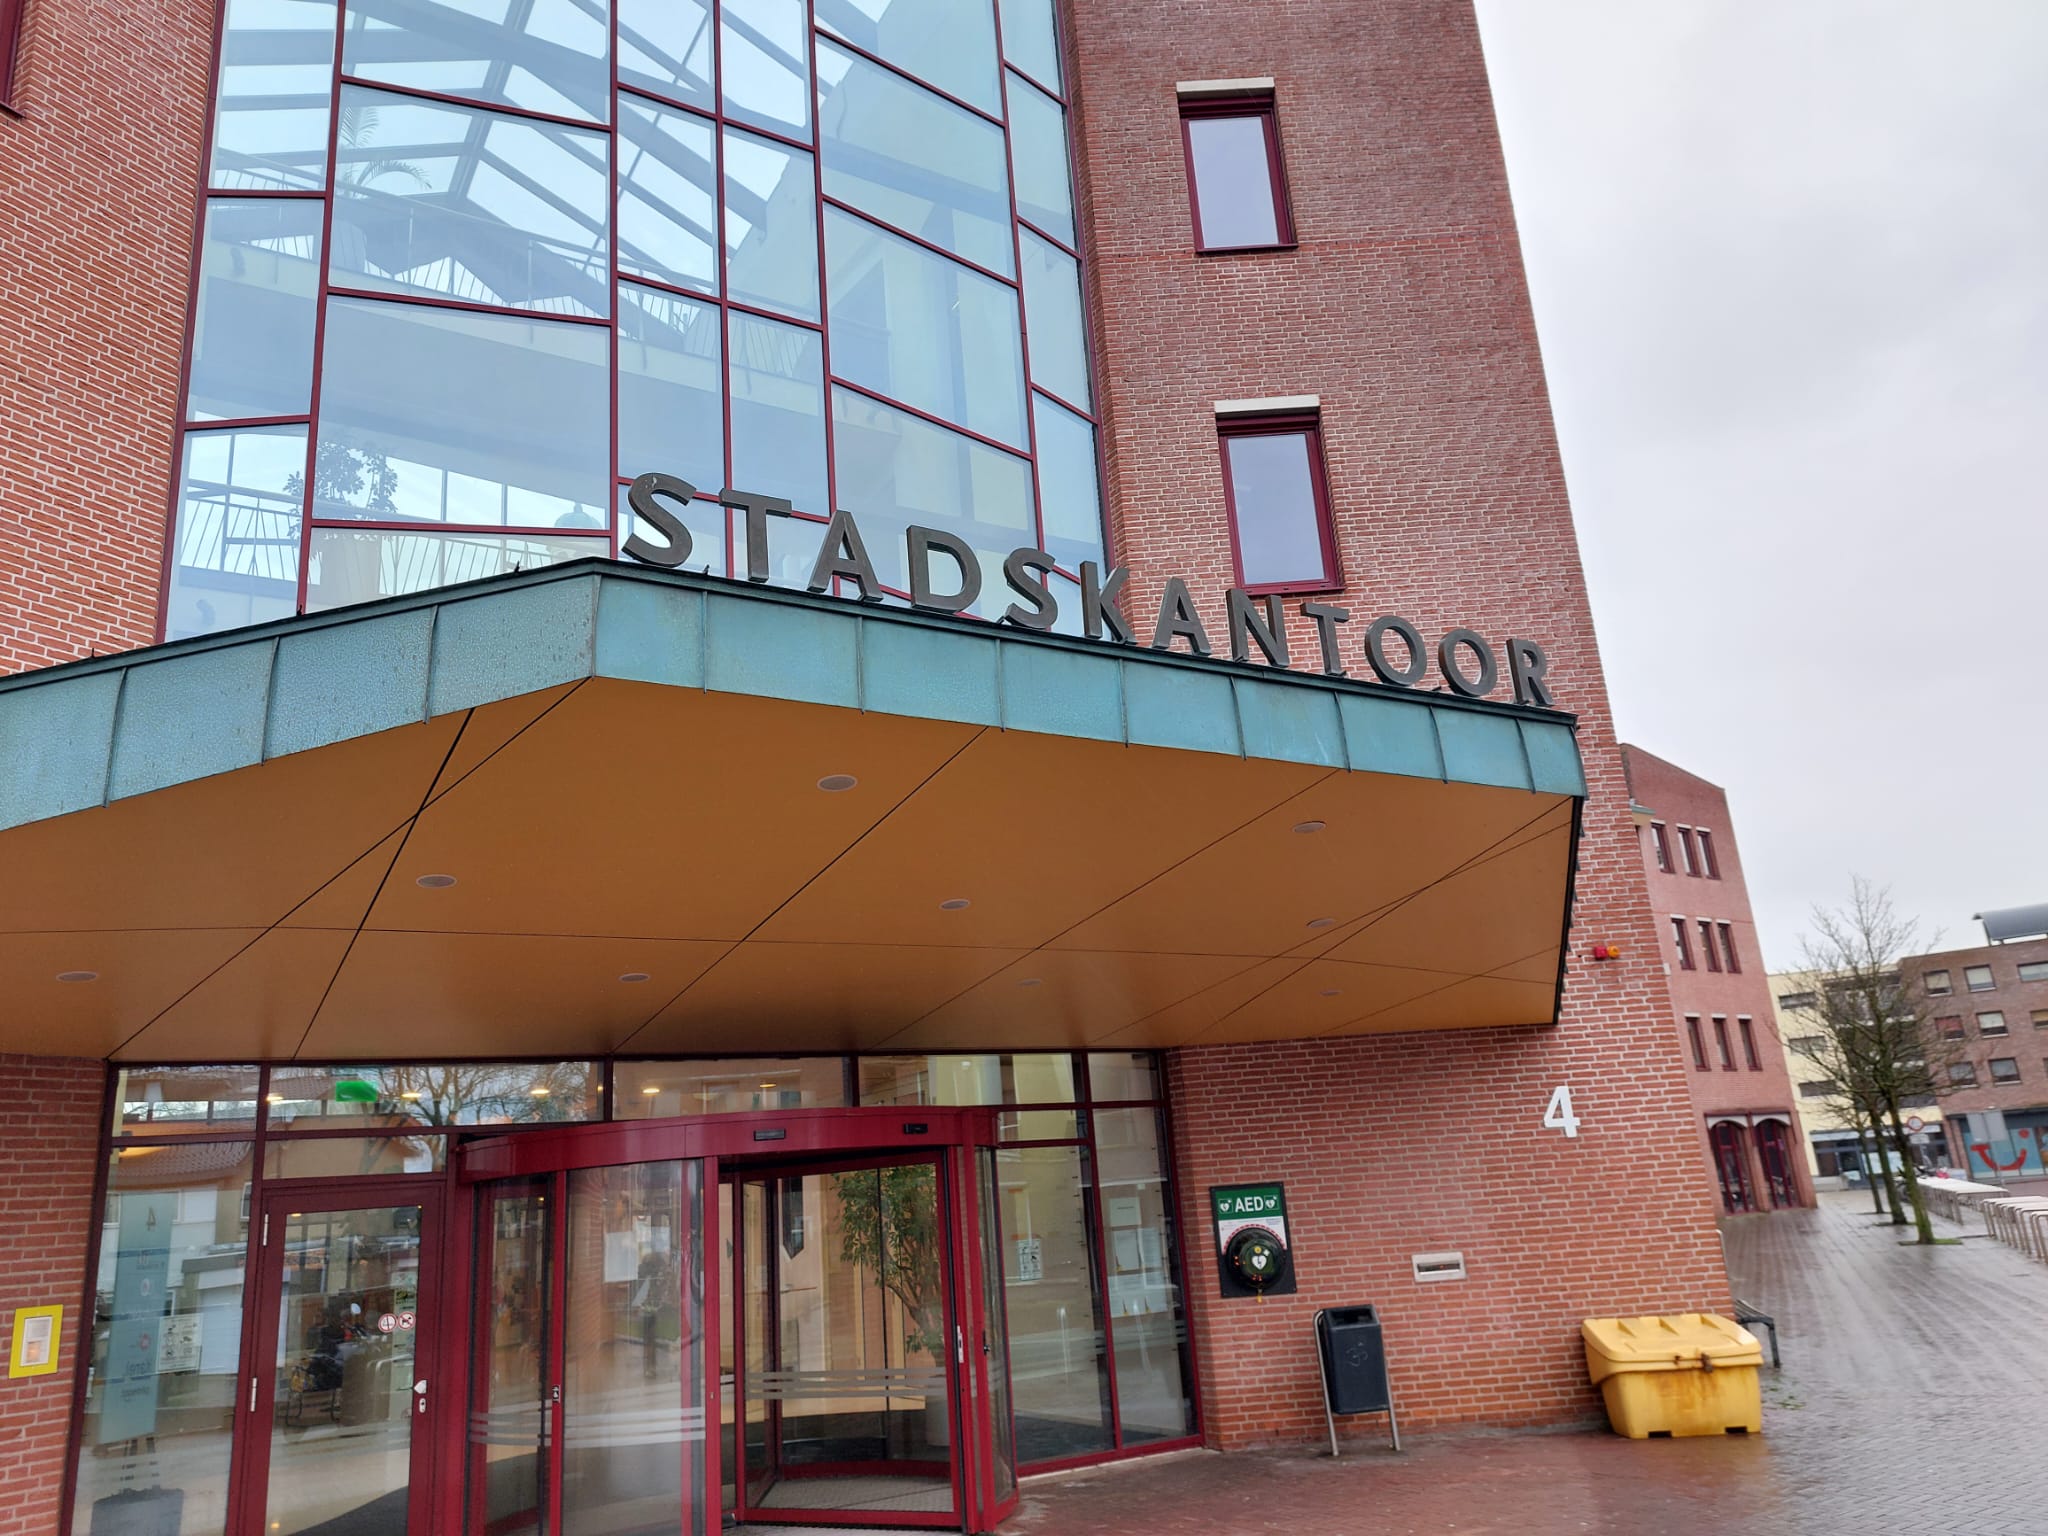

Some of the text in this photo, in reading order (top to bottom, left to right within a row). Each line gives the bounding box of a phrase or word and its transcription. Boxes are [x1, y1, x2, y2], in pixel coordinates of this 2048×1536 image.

[621, 472, 1554, 708] STADSKANTOOR
[1543, 1085, 1581, 1138] 4
[1234, 1196, 1264, 1213] AED
